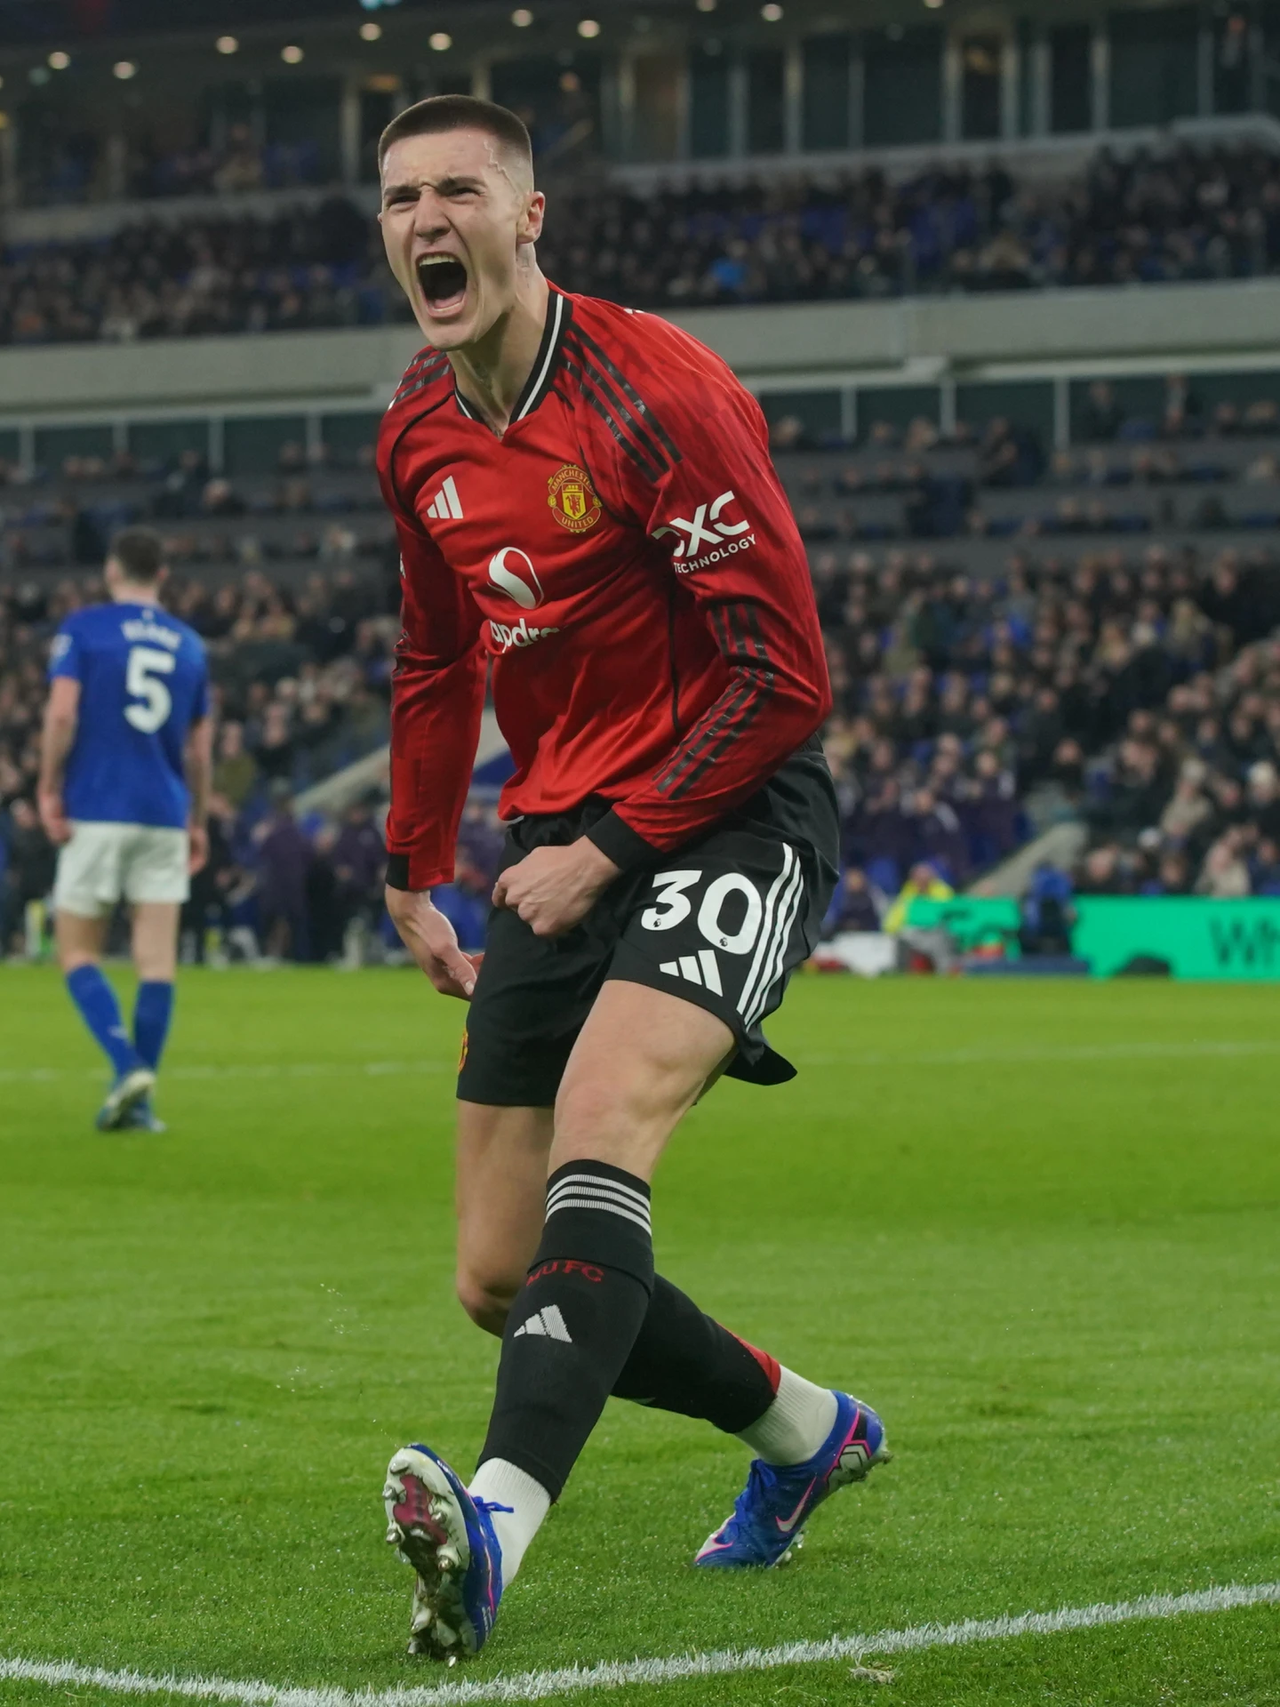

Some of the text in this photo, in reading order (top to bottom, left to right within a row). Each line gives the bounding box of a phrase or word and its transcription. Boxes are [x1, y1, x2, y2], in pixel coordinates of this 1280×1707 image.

[561, 516, 594, 529] UNITED
[673, 533, 757, 574] TECHNOLOGY
[124, 645, 175, 734] 5
[641, 870, 762, 955] 30
